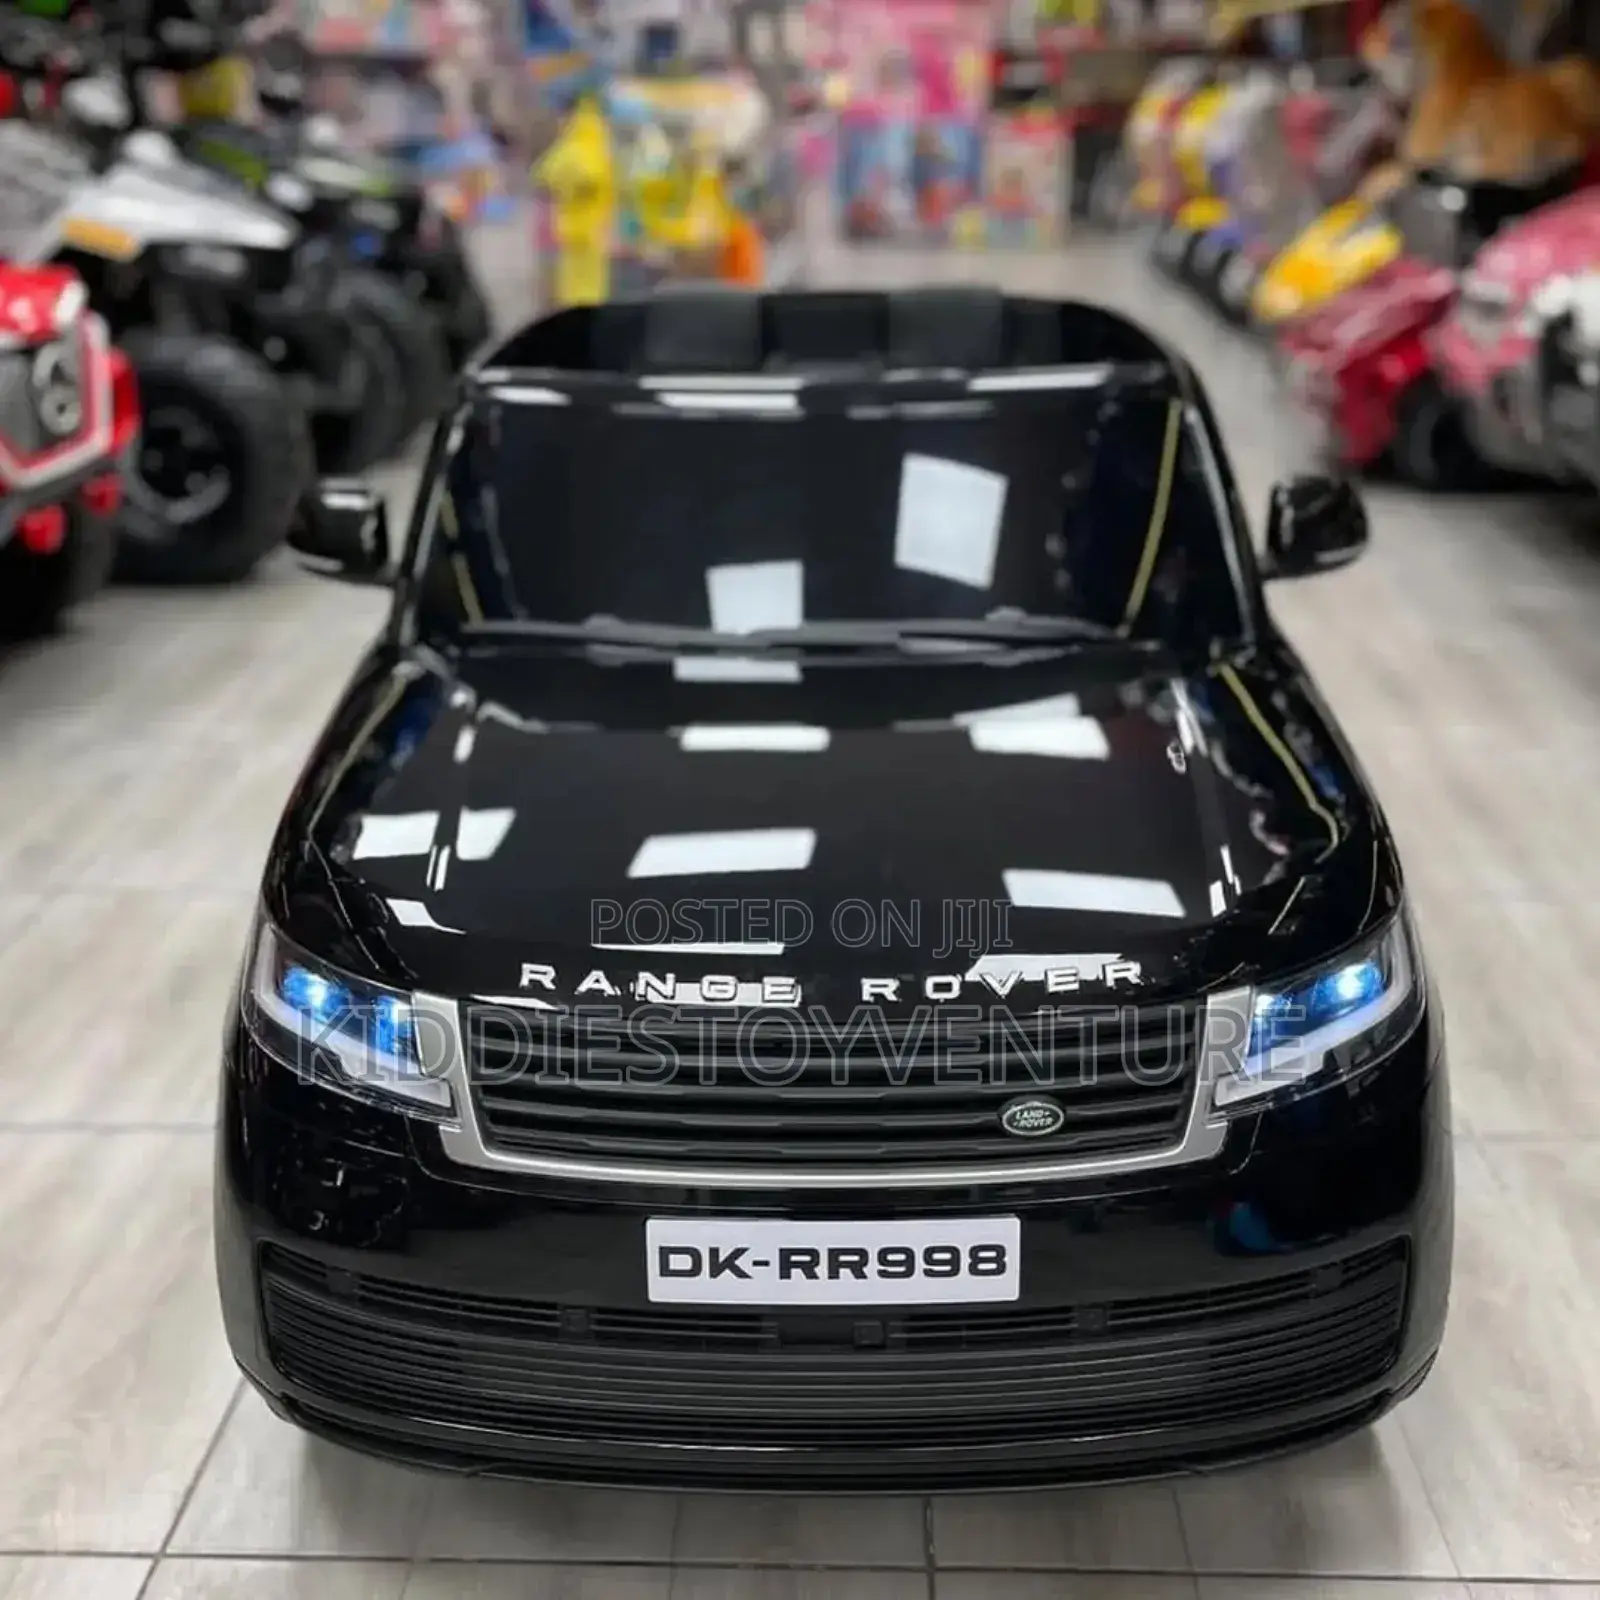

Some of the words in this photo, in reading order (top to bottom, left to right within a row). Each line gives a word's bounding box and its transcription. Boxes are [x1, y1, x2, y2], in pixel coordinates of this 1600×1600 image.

[519, 963, 801, 1004] RANGE
[860, 960, 1144, 1003] ROVER
[657, 1244, 1007, 1281] DK-RR998
